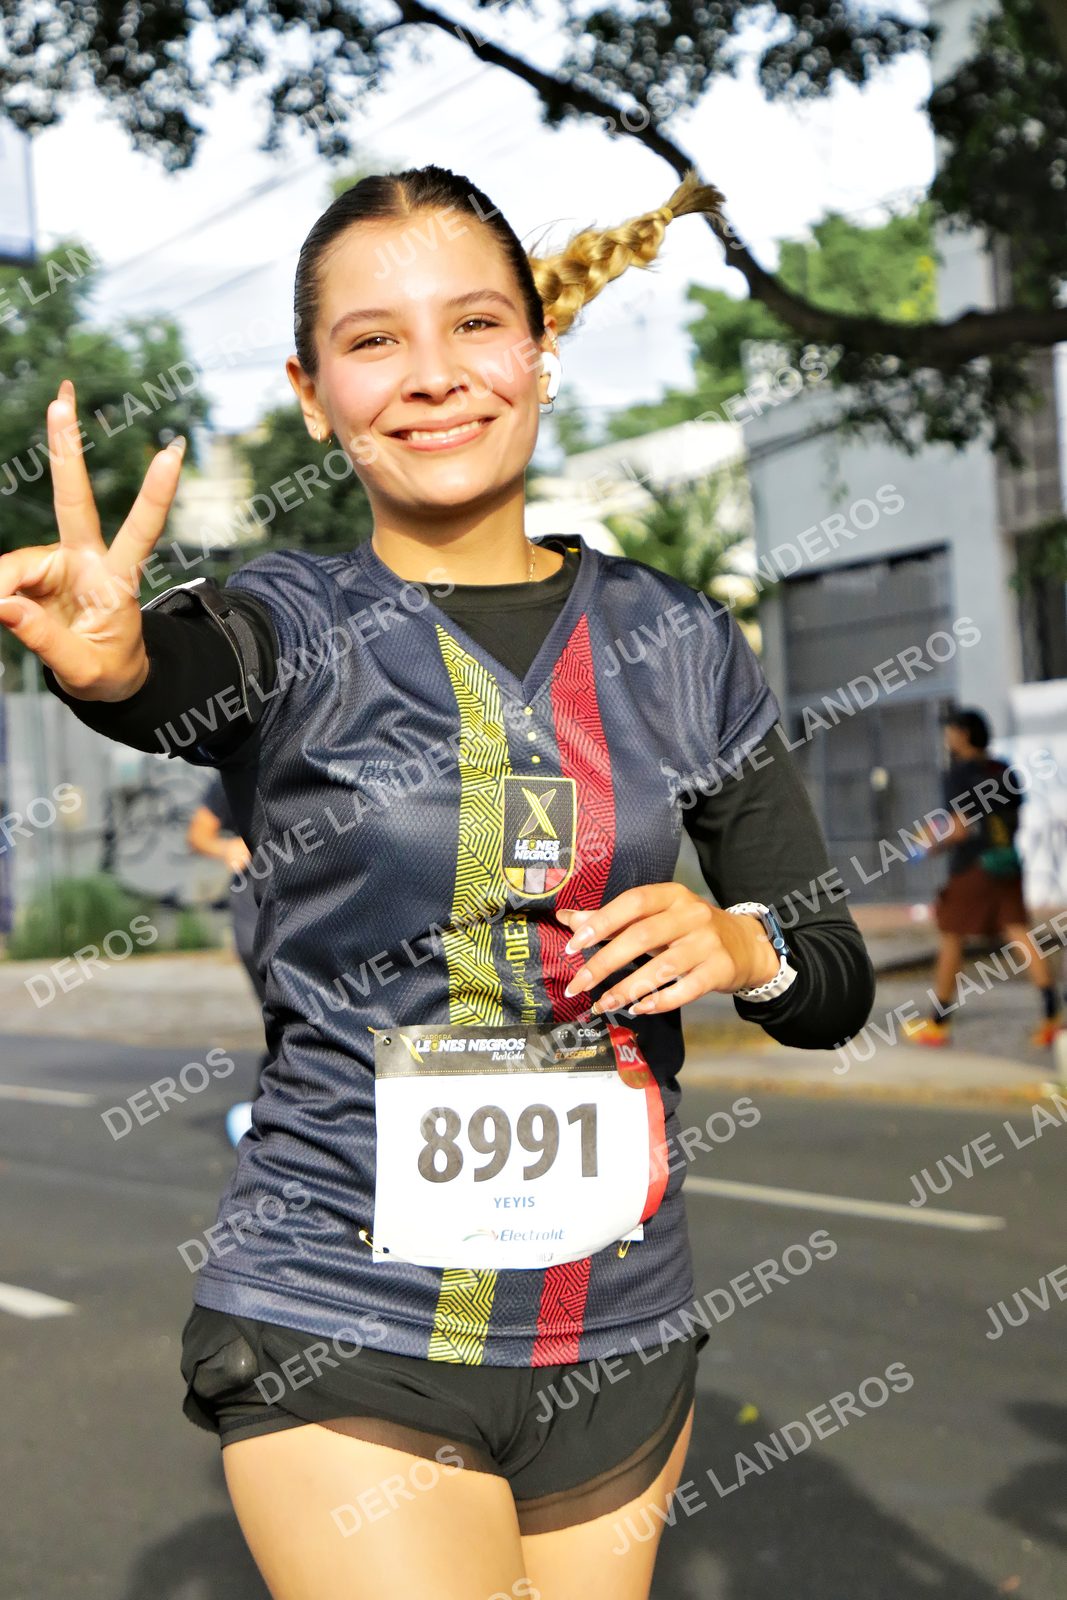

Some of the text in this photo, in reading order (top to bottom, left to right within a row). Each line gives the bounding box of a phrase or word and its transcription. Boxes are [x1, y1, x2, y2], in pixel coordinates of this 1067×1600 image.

[365, 760, 397, 769] PIEL
[515, 839, 560, 851] LEONES
[514, 850, 560, 860] NEGROS
[504, 914, 531, 960] DIEZ
[415, 1037, 526, 1053] LEONES NEGROS
[417, 1103, 599, 1184] 8991
[494, 1196, 536, 1209] YEYIS
